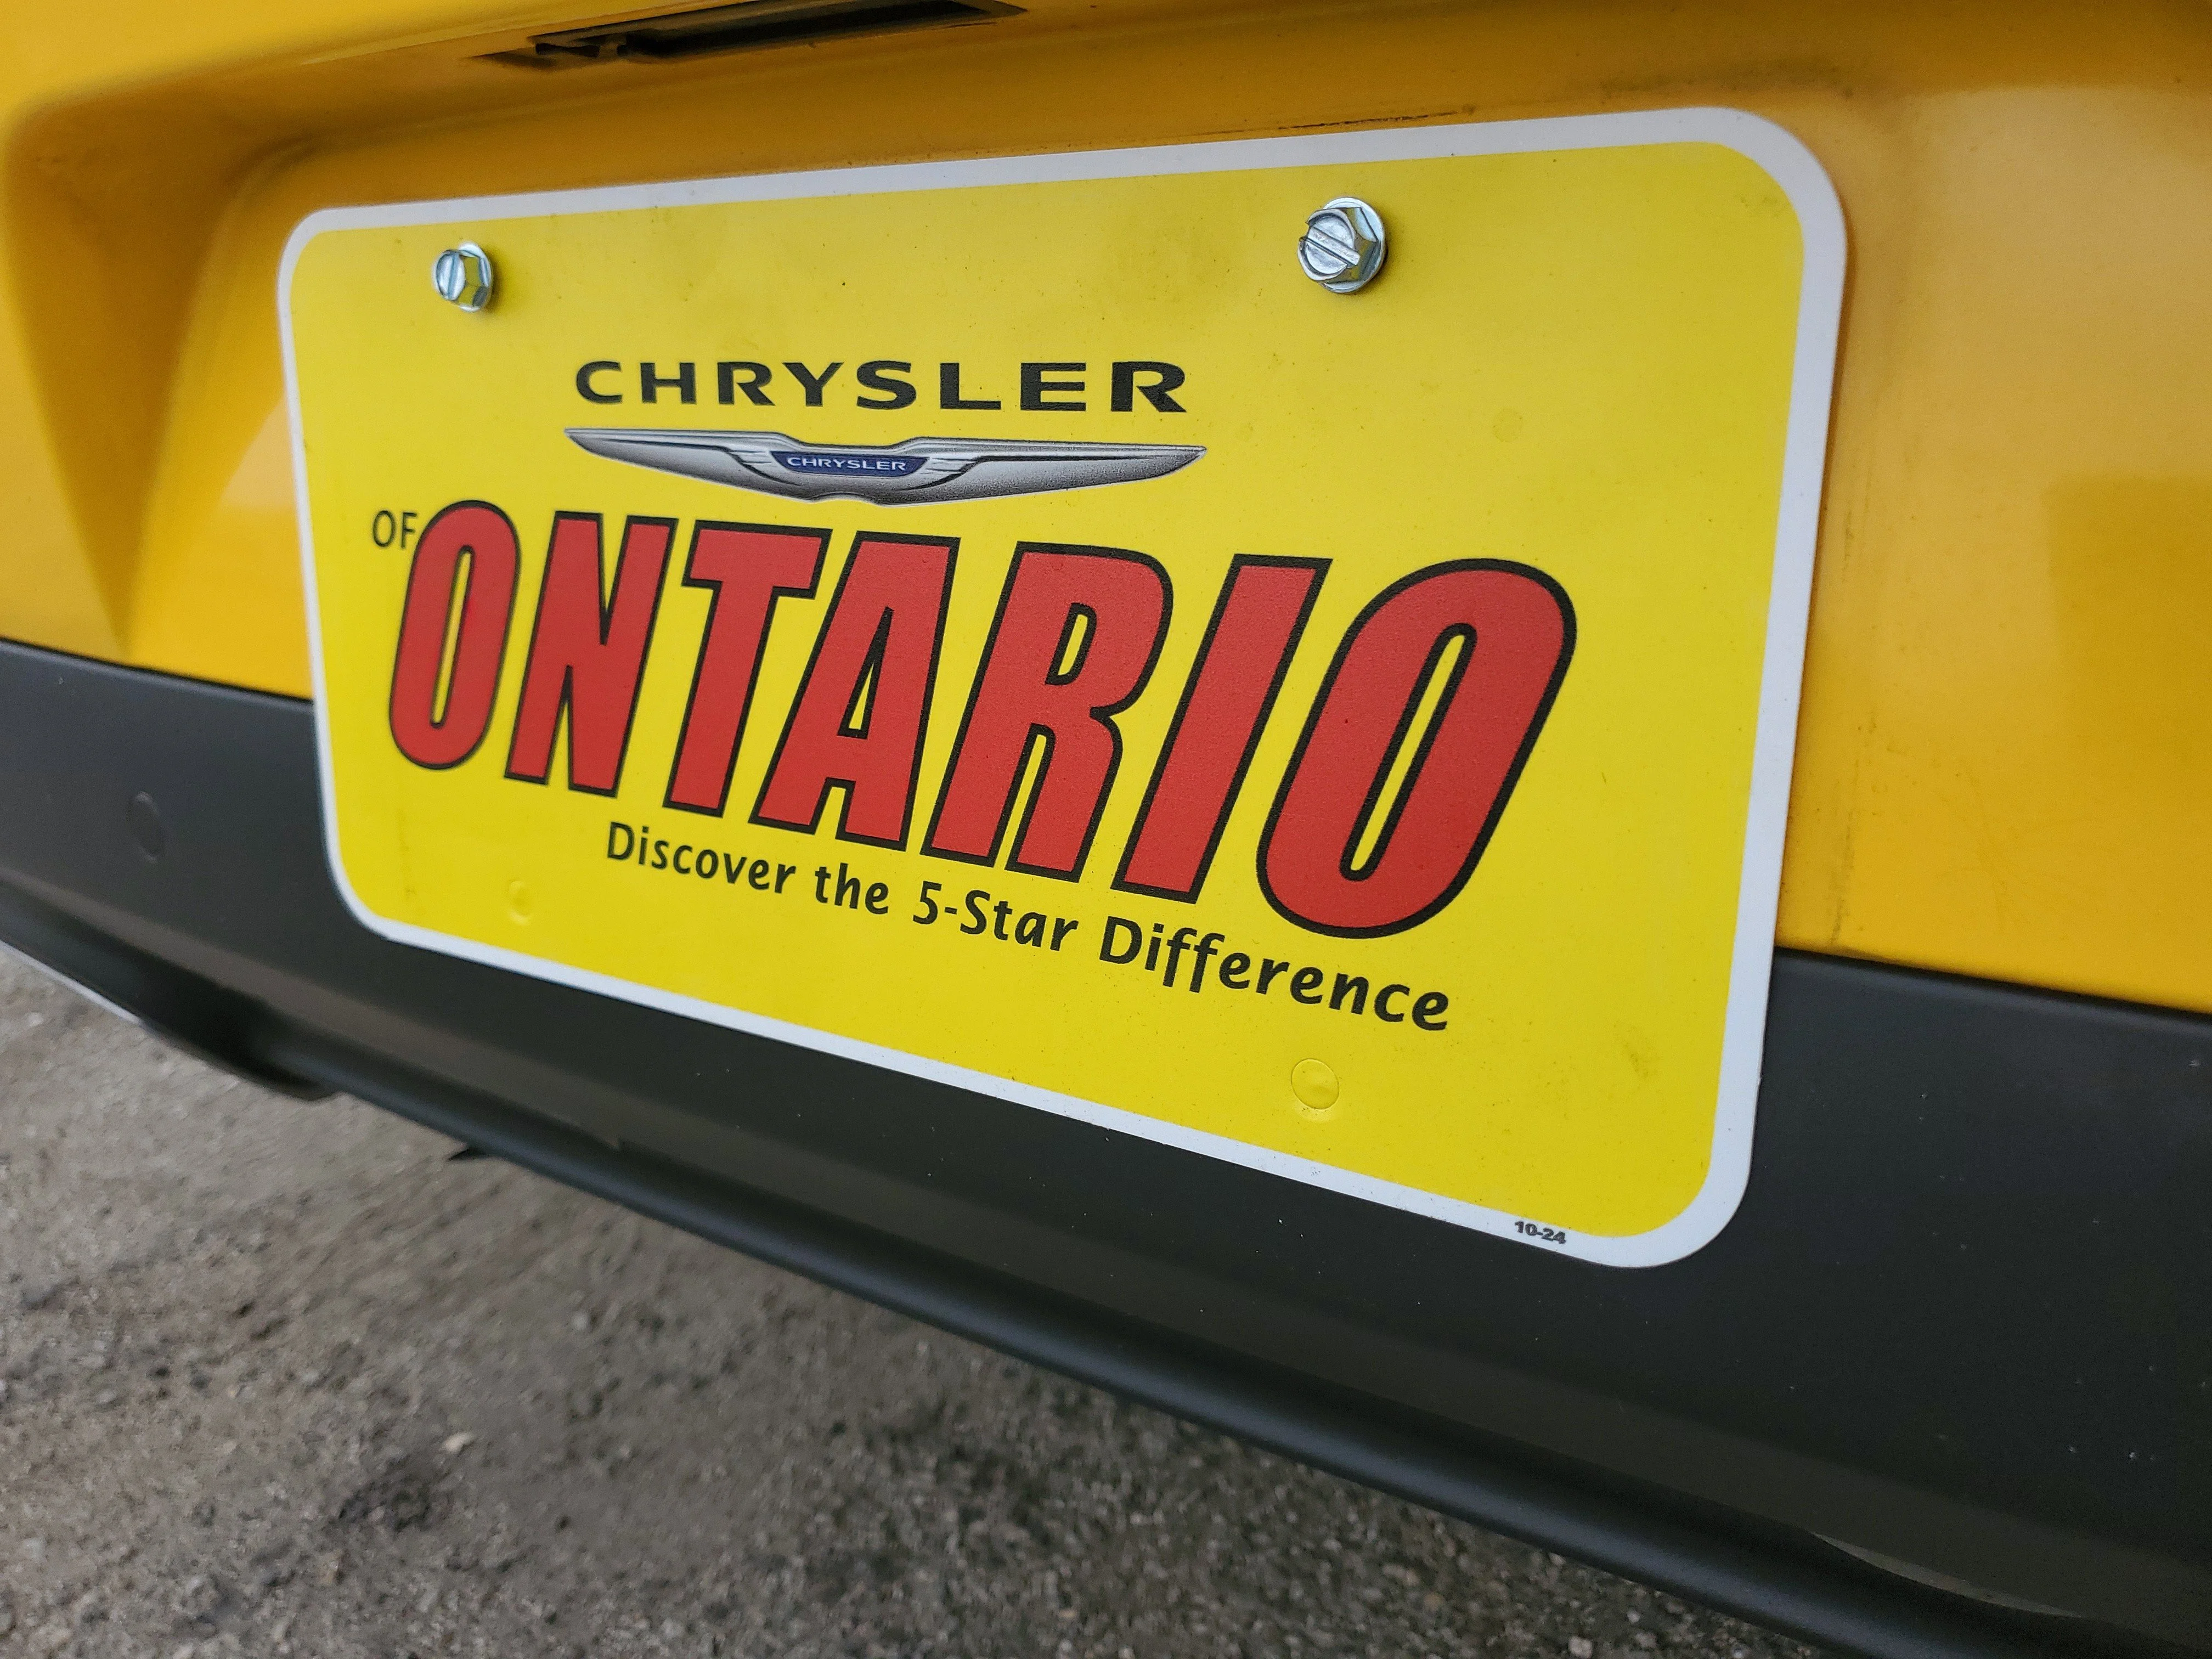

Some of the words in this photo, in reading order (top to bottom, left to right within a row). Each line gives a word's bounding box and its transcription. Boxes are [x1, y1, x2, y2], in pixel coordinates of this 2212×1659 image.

[575, 359, 1188, 414] CHRYSLER
[787, 456, 906, 471] CHRYSLER
[372, 510, 417, 549] OF
[388, 498, 1578, 941] ONTARIO
[607, 821, 797, 894] Discover
[814, 862, 889, 915] the
[912, 880, 1080, 952] 5-Star
[1098, 915, 1449, 1031] Difference
[1515, 1220, 1566, 1244] 10-24
